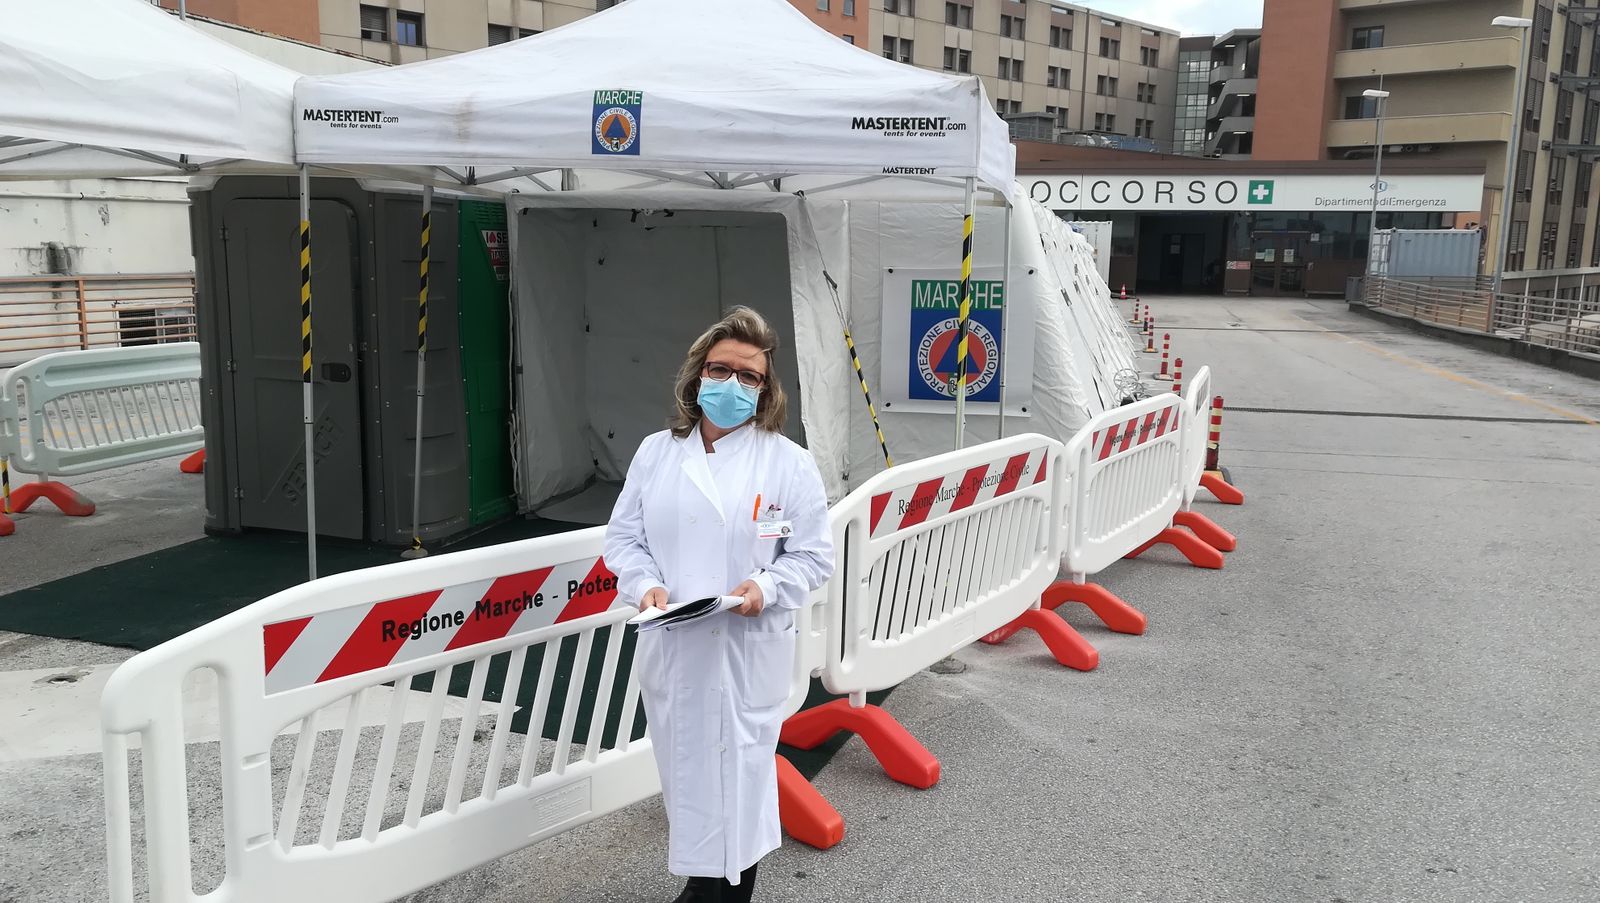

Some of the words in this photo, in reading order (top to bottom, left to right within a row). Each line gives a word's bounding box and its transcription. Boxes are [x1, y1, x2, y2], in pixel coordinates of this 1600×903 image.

[595, 91, 642, 105] MARCHE
[882, 166, 937, 175] MASTERTENT
[1380, 196, 1389, 206] di
[1389, 196, 1447, 208] Emergenza
[919, 325, 946, 393] PROTEZIONE
[966, 333, 998, 395] REGIONALE
[898, 489, 935, 517] Regione
[935, 482, 965, 504] Marche
[972, 470, 1009, 492] Protezione
[381, 609, 465, 642] Regione
[475, 591, 544, 622] Marche
